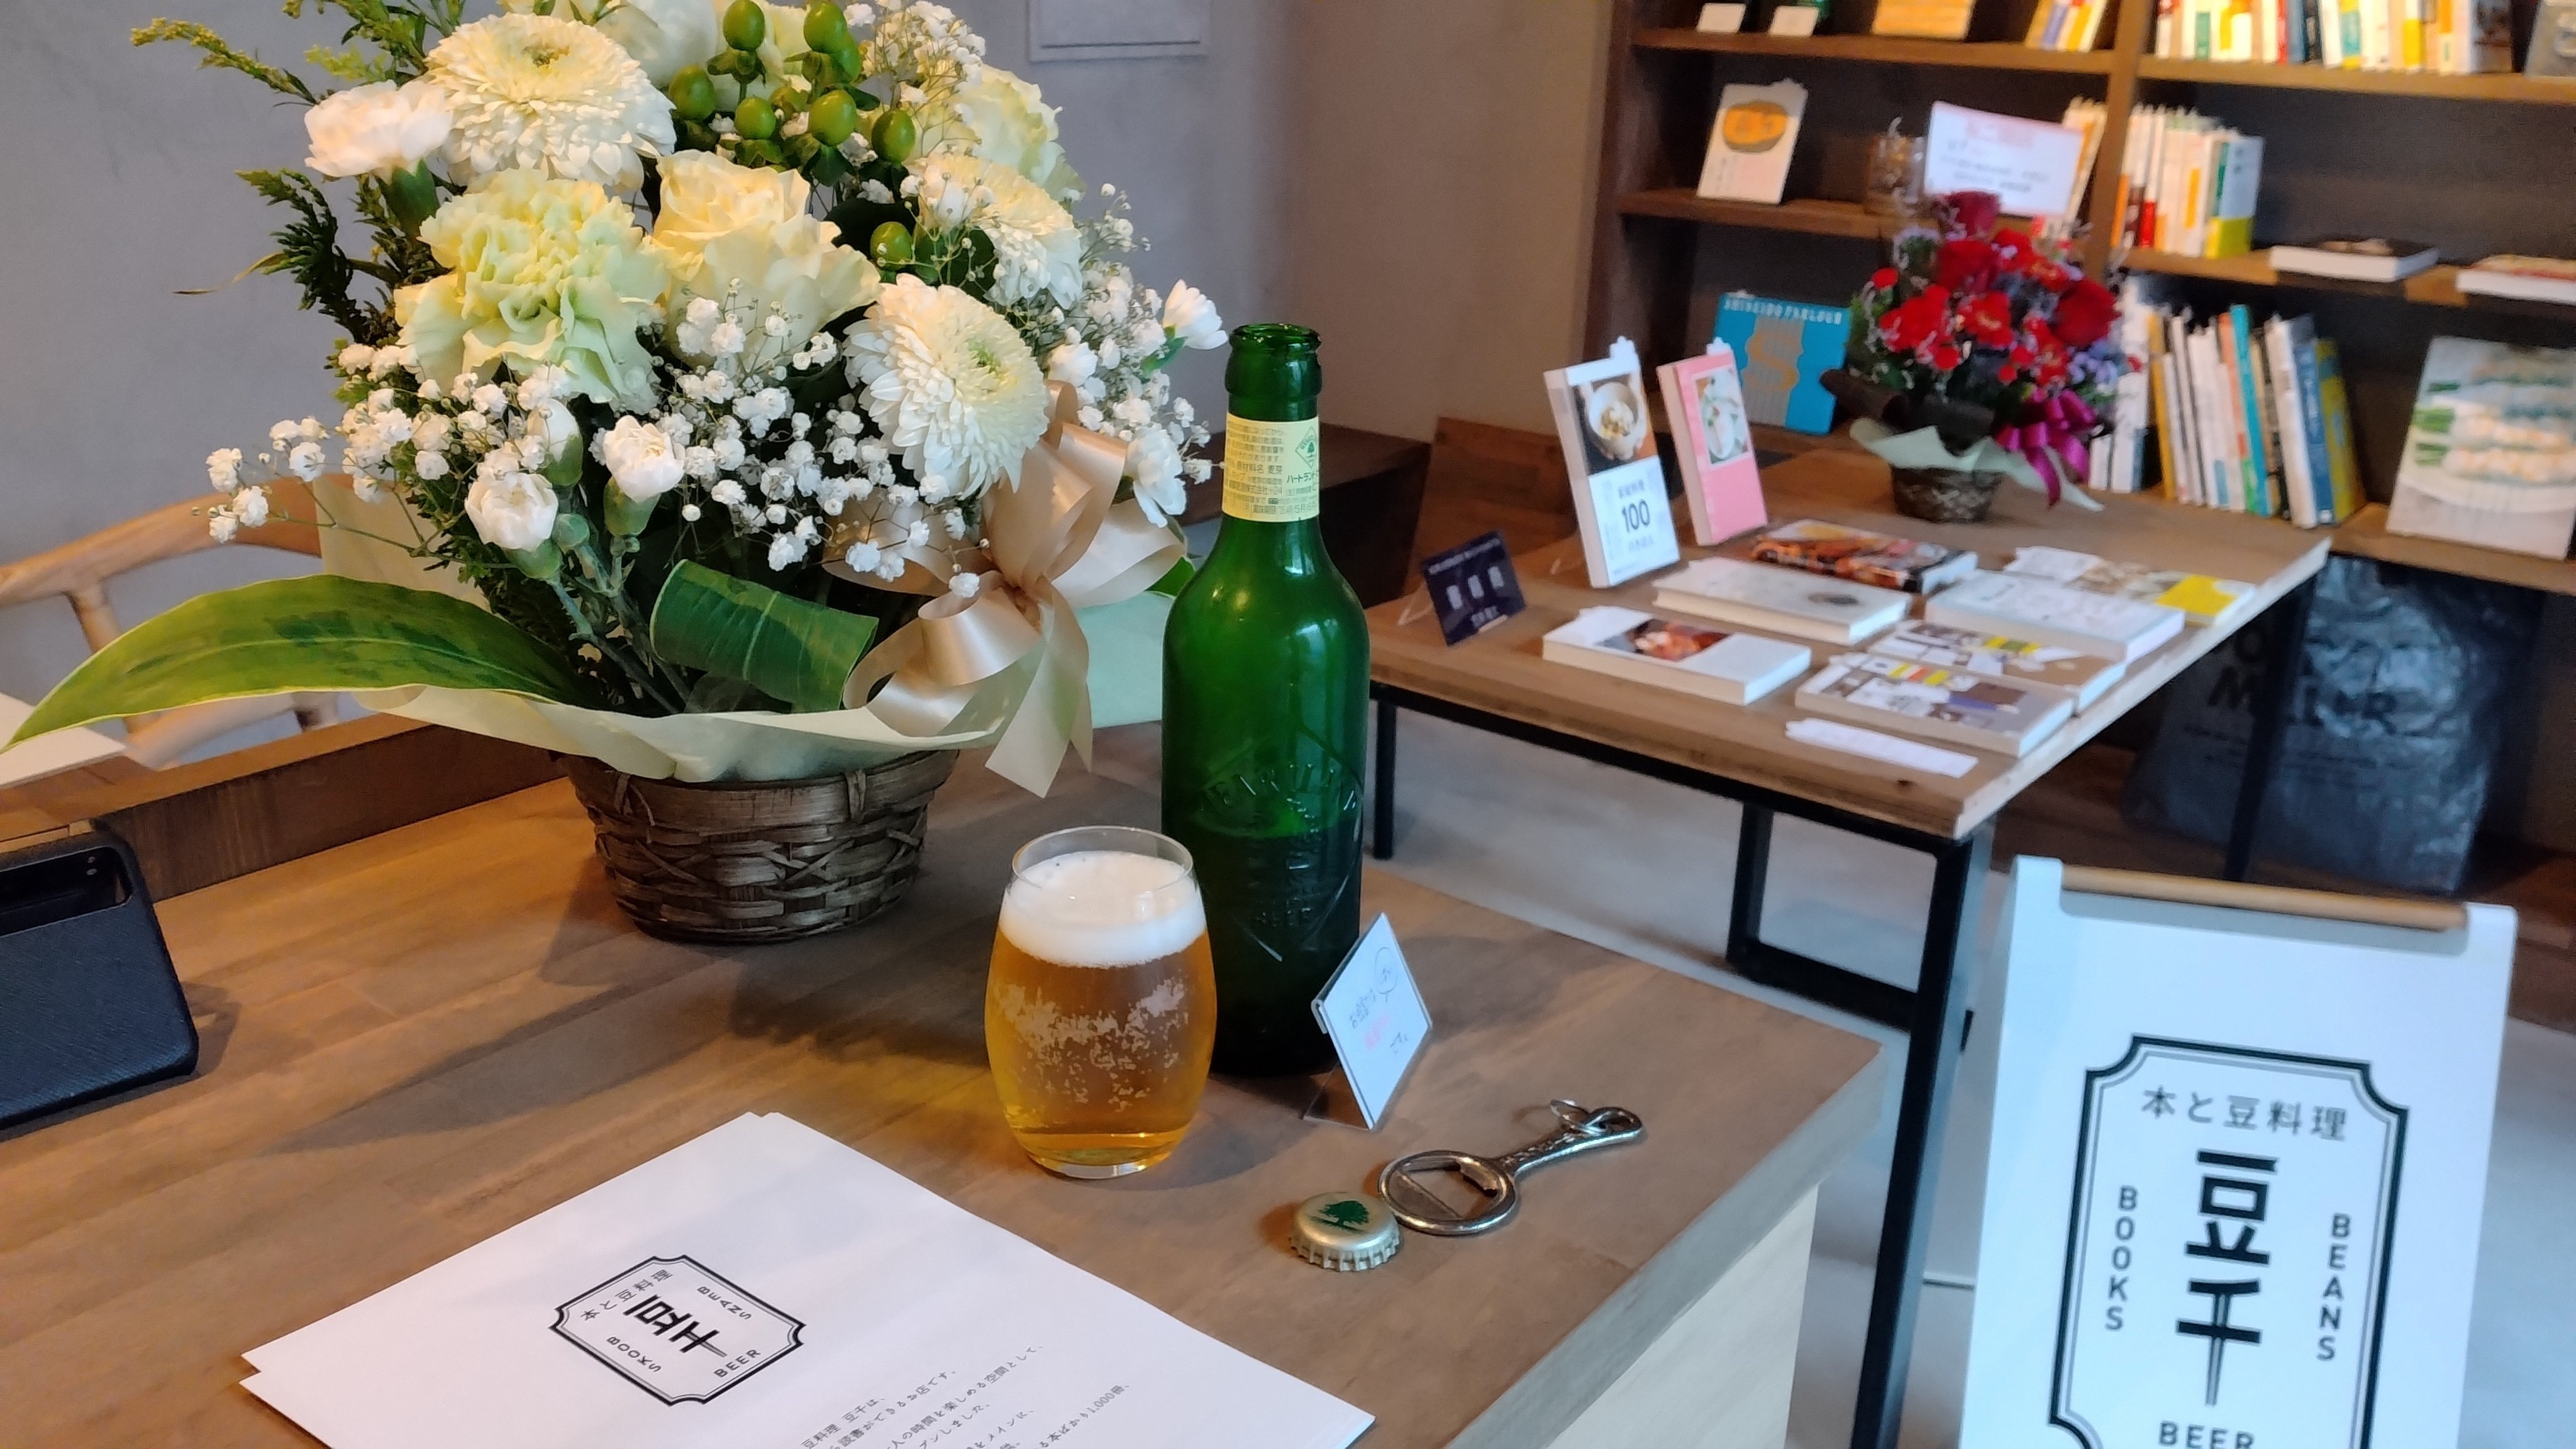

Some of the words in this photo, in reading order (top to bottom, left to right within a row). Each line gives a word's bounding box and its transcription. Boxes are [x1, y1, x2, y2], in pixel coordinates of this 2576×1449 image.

[1621, 499, 1652, 534] 100
[2140, 1085, 2348, 1142] 本と豆料理
[2104, 1185, 2138, 1332] BOOKS
[580, 1269, 674, 1321] 本と豆料理
[696, 1285, 752, 1320] BEANS
[2316, 1213, 2351, 1361] BEANS
[606, 1335, 662, 1374] BOOKS
[713, 1348, 761, 1379] BEER
[967, 1410, 1035, 1449] をメインに、
[2158, 1420, 2255, 1449] BEER
